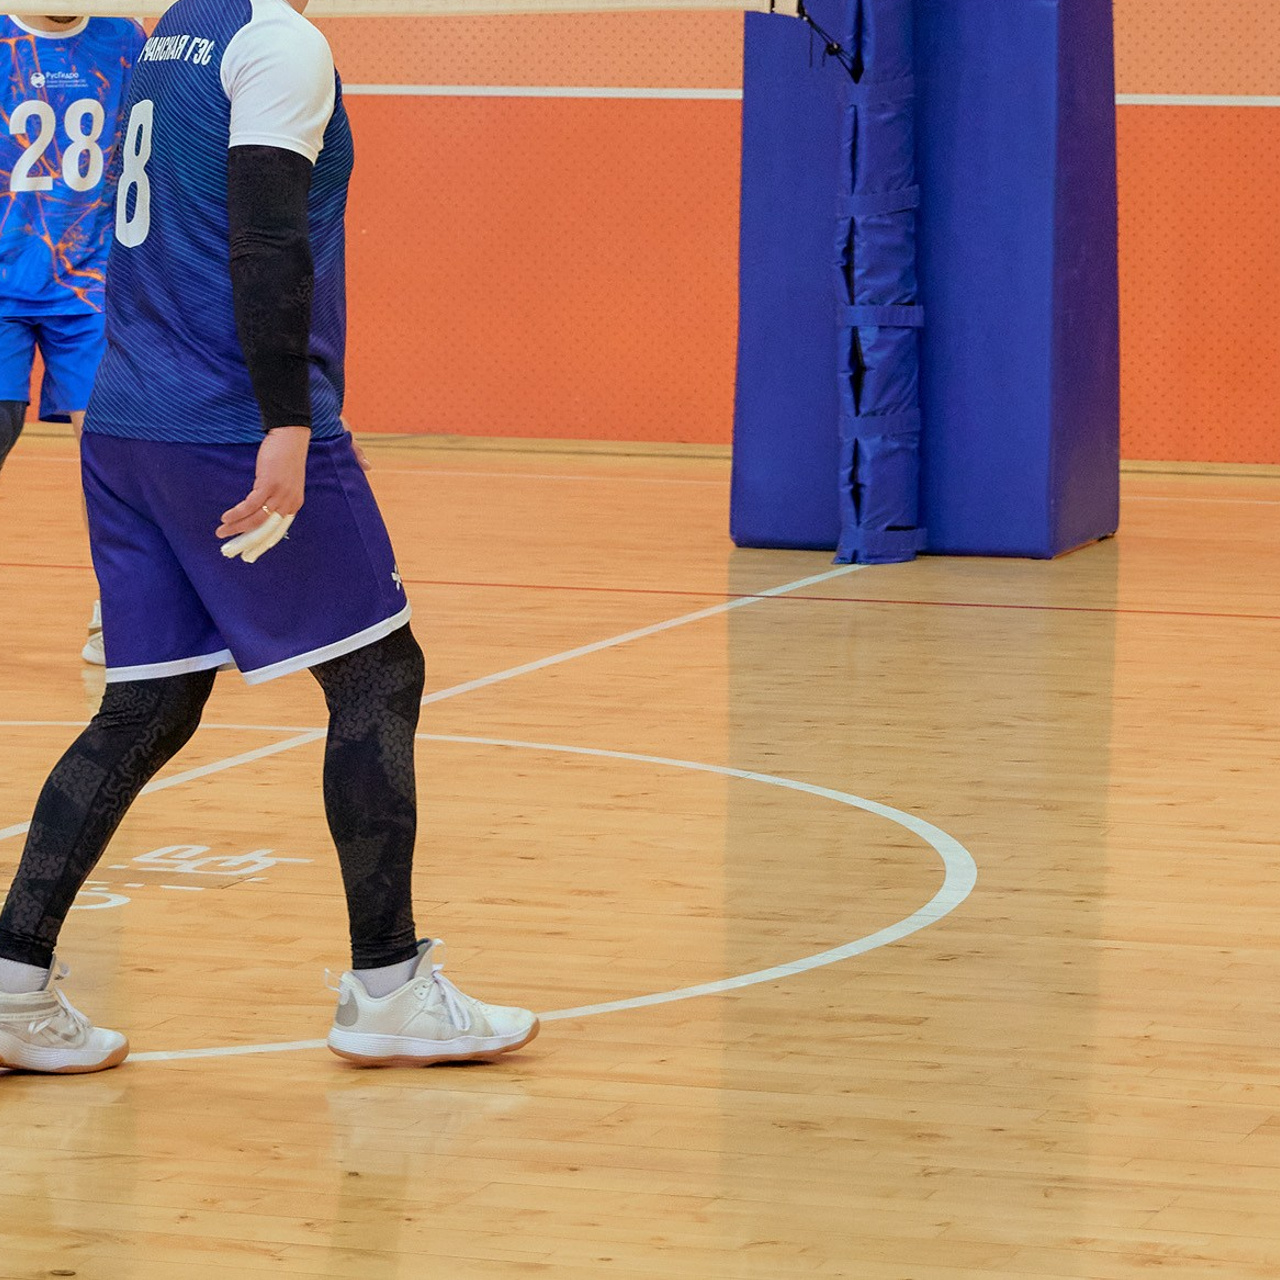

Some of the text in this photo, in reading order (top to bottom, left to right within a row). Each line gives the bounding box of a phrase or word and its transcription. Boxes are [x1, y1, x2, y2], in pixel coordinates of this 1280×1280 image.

[183, 36, 215, 66] ГЭС
[9, 98, 105, 192] 28
[115, 99, 154, 248] 8
